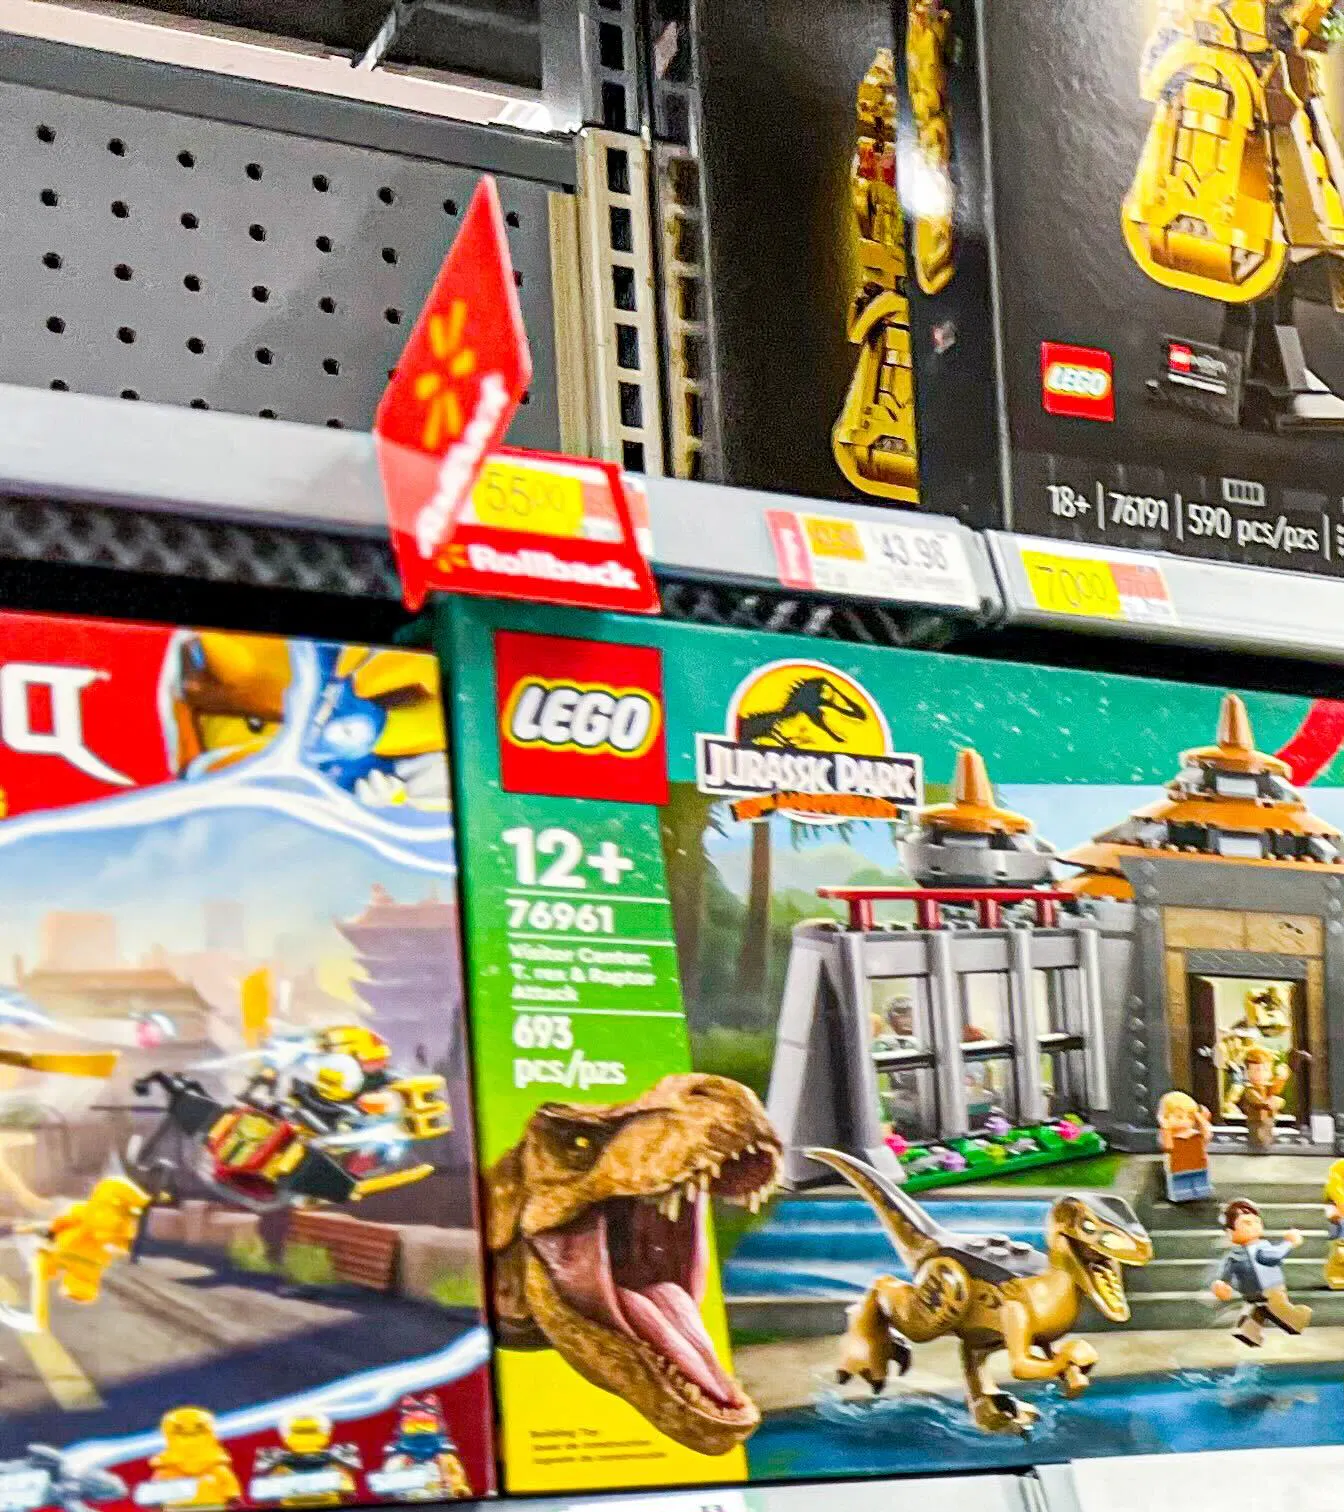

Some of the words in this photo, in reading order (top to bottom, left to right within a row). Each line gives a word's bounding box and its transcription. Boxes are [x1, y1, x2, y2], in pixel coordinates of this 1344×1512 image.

[1046, 365, 1108, 398] LEGO
[1049, 484, 1090, 518] 18+
[1108, 492, 1170, 532] 76191
[1187, 505, 1231, 539] 590
[1237, 512, 1319, 557] pcs/pzs
[468, 544, 641, 590] Rollback
[510, 683, 651, 751] LEGO
[705, 743, 833, 792] JURASSIC
[836, 755, 916, 799] PARK
[503, 827, 633, 888] 12+
[505, 901, 614, 932] 76961
[509, 944, 575, 963] Visitor
[511, 985, 578, 1002] Attack
[590, 968, 656, 988] Raptor
[512, 1017, 573, 1048] 693
[514, 1050, 626, 1090] pcs/pzs
